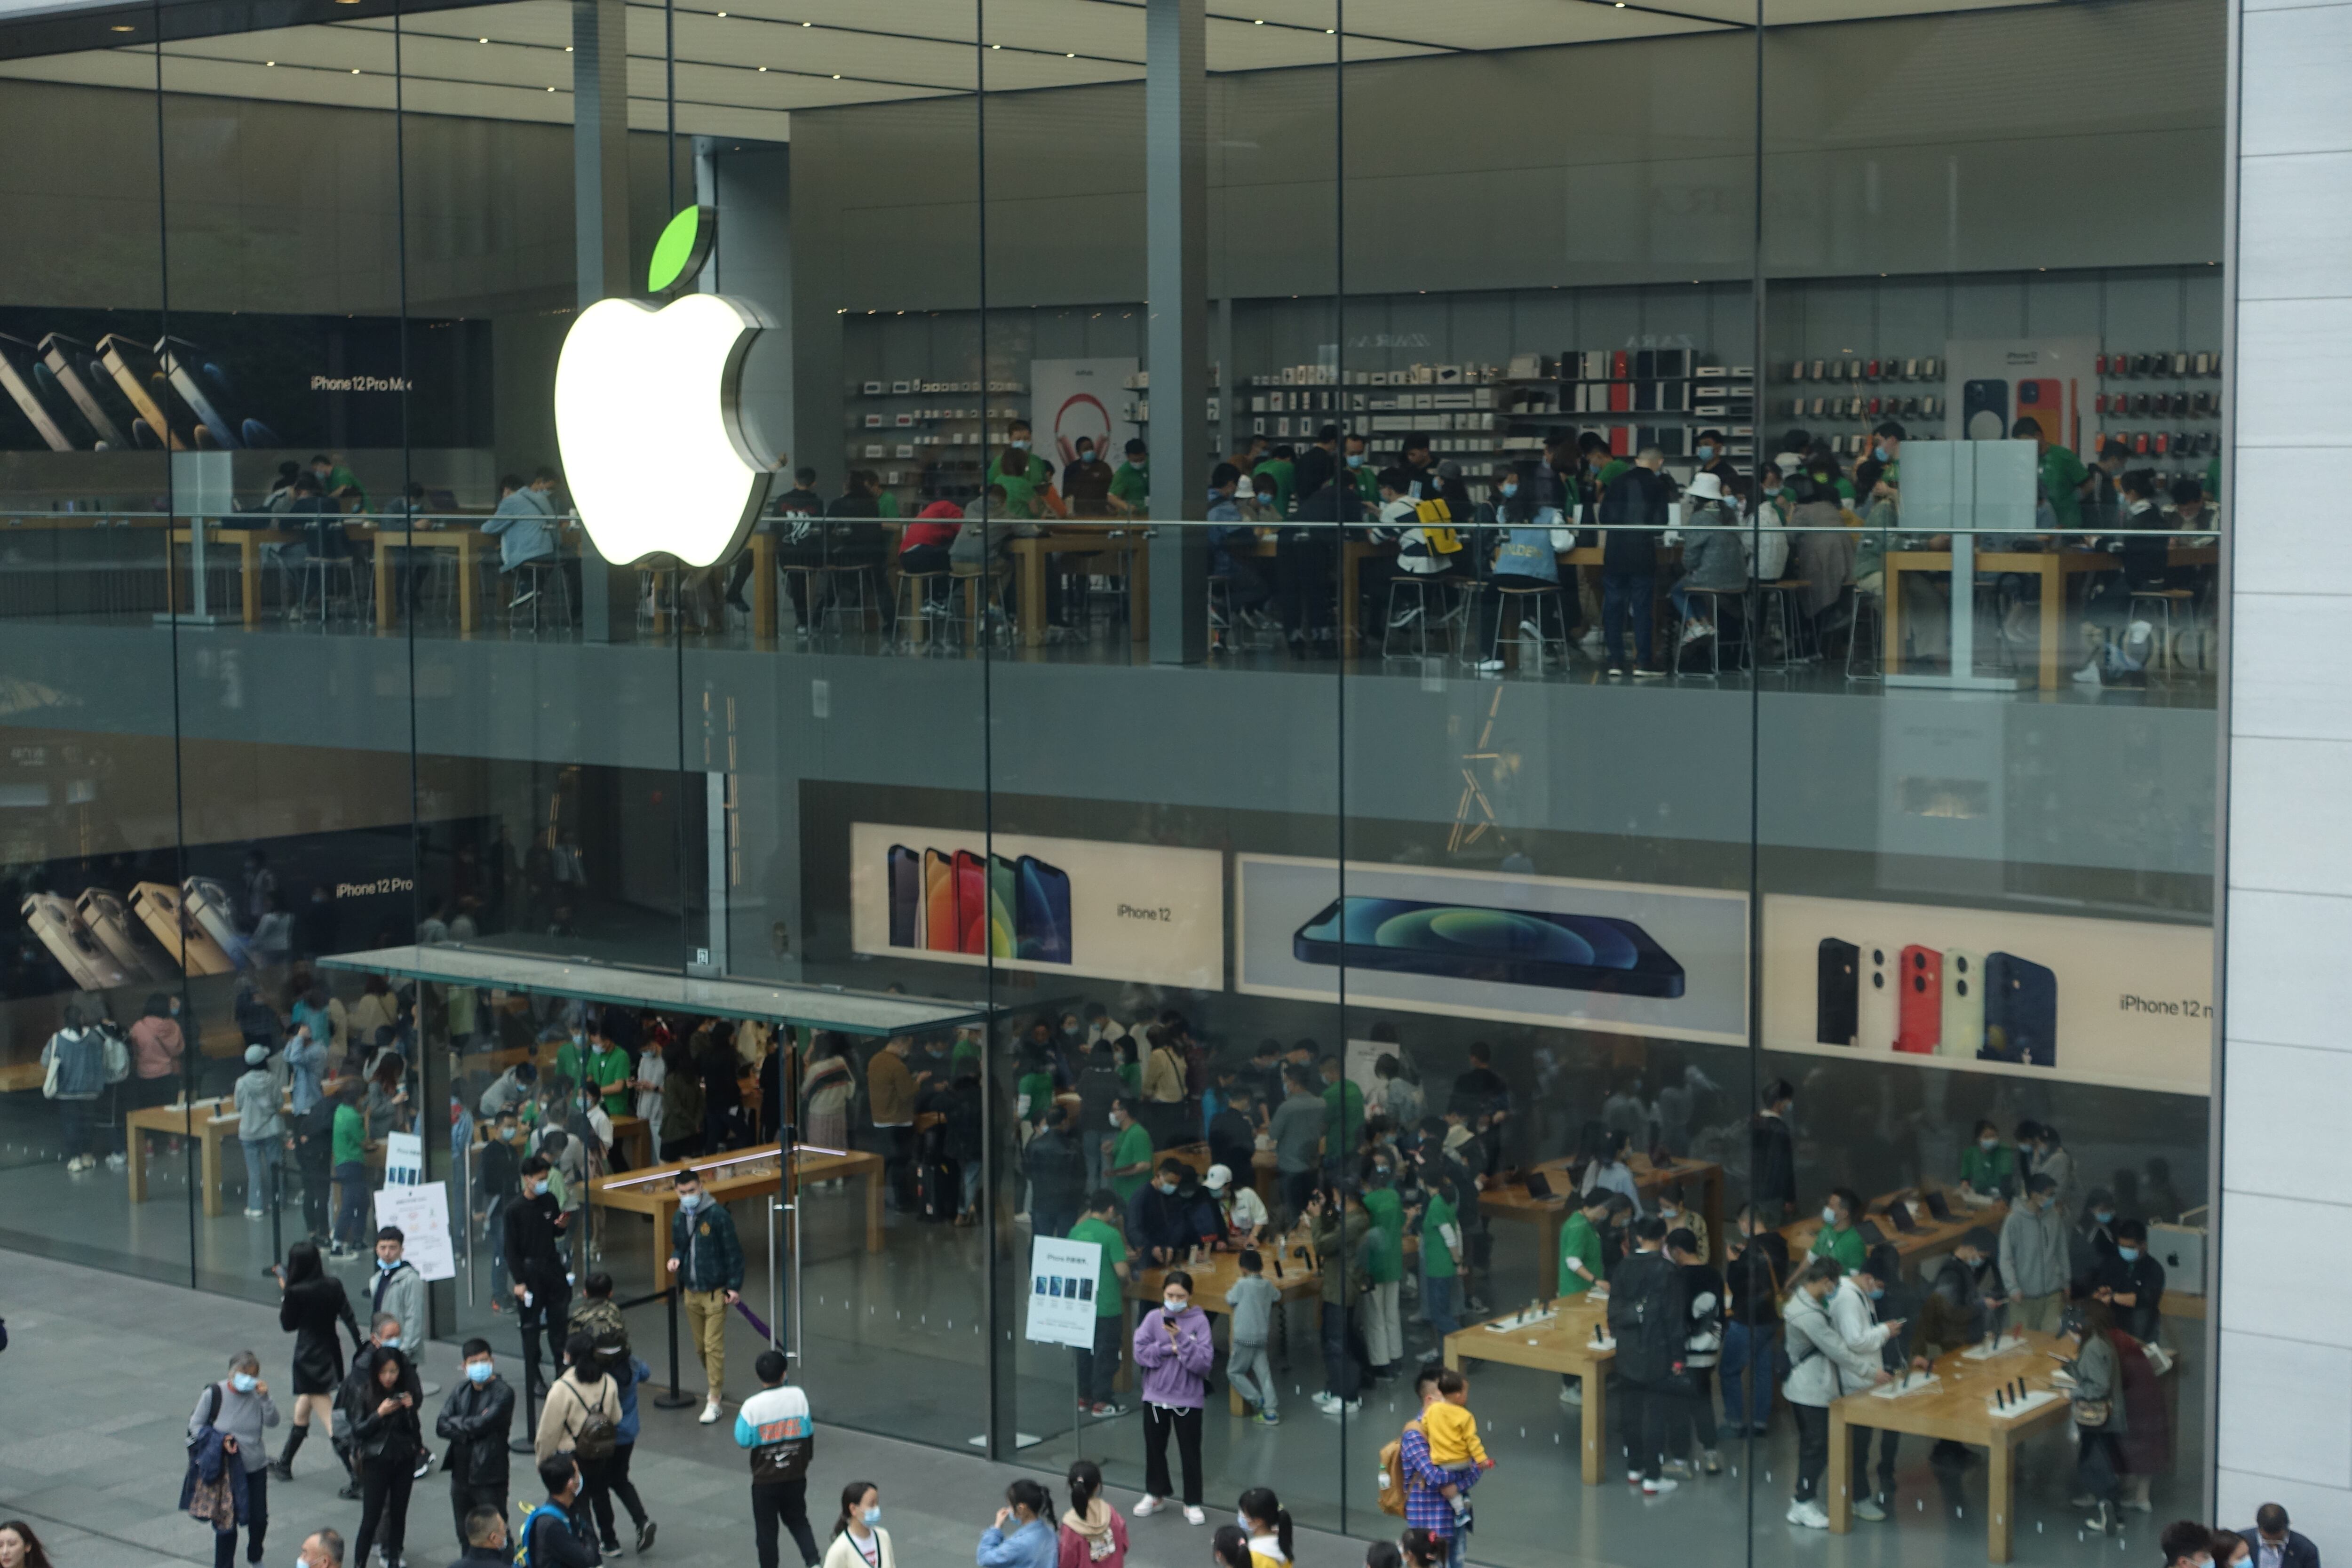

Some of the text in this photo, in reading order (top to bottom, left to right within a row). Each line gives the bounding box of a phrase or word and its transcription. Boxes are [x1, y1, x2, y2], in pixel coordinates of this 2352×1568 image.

[311, 375, 351, 391] iPhone
[352, 376, 366, 391] 12
[366, 376, 388, 391] Pro
[336, 877, 413, 899] iPhone 12 Pro
[1117, 903, 1172, 922] iPhone 12
[2120, 994, 2179, 1016] iPhone
[2182, 999, 2201, 1018] 12
